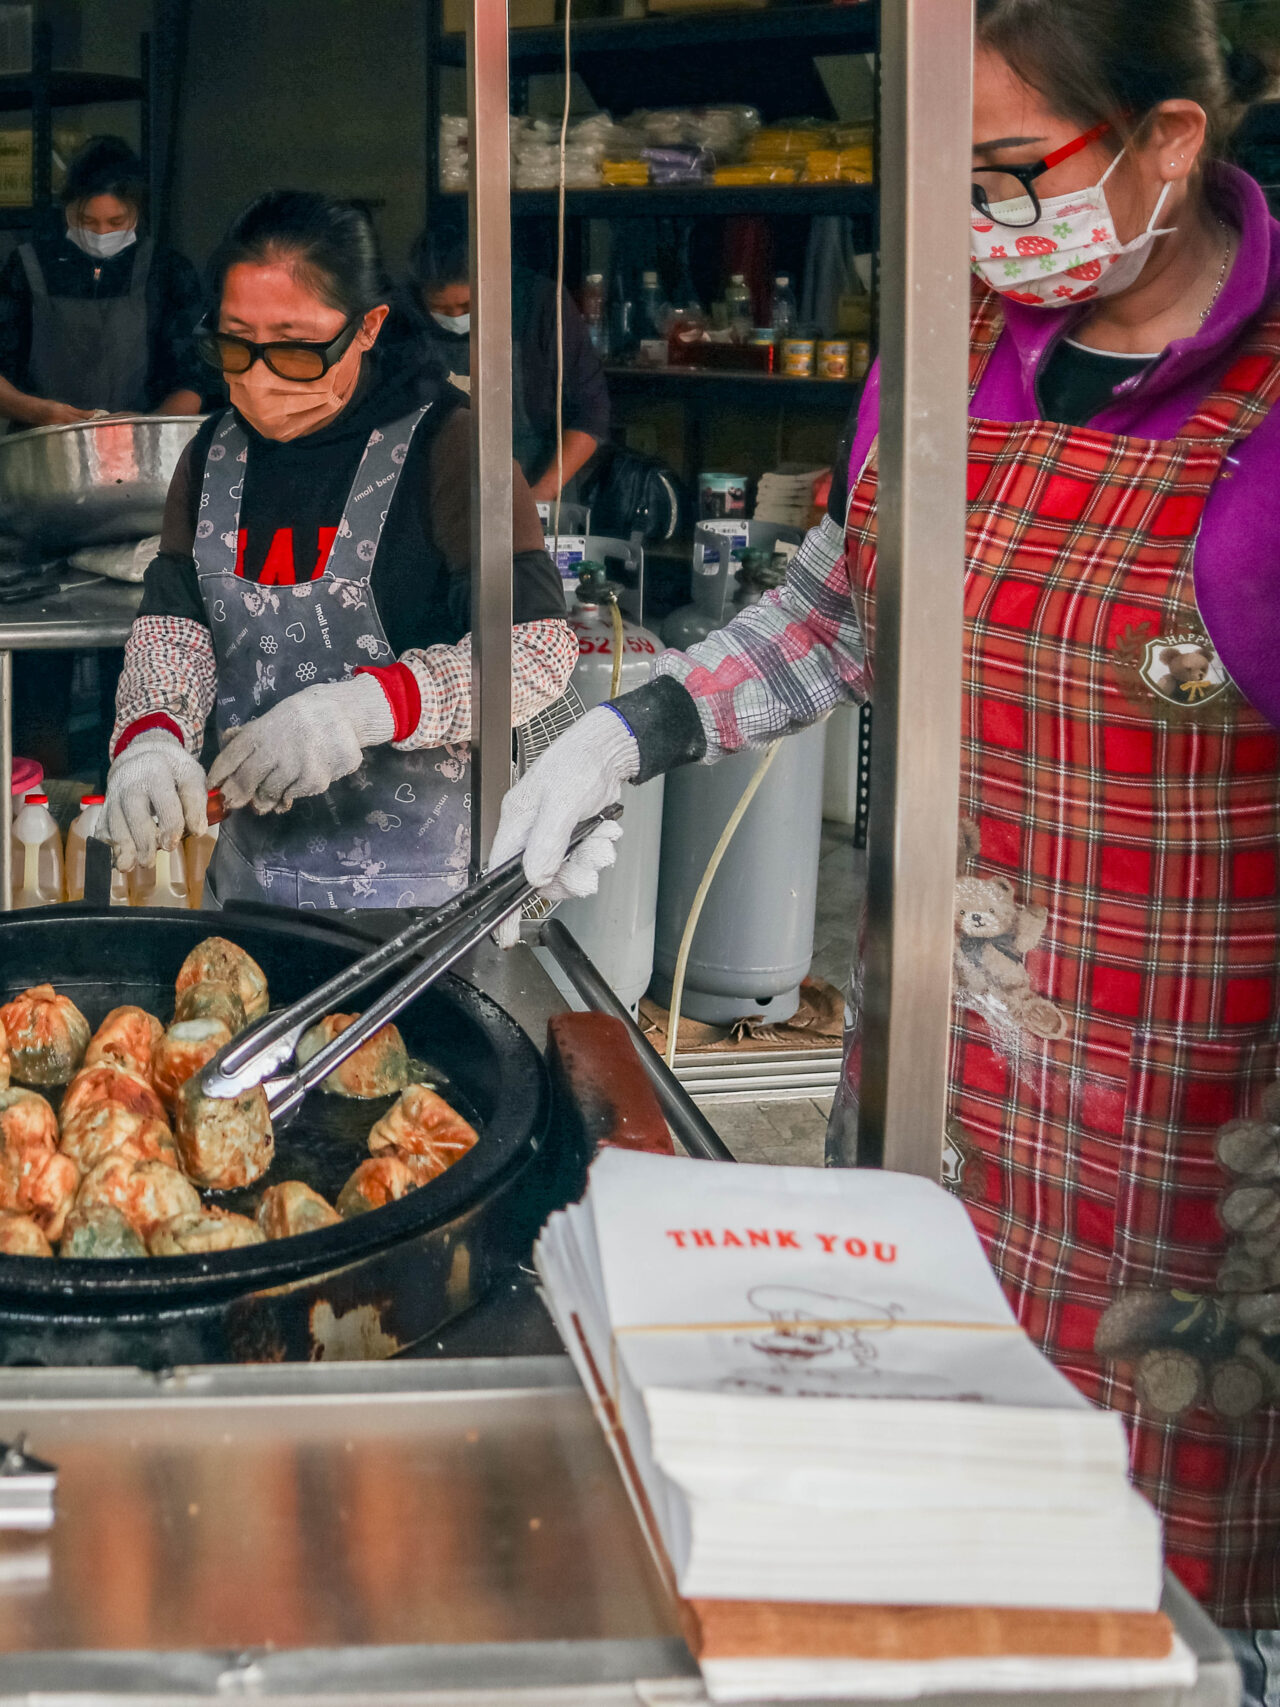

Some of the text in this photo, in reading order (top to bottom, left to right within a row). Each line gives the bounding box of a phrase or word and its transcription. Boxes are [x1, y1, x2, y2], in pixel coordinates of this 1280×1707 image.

[314, 603, 332, 649] small bear
[666, 1228, 897, 1263] THANK YOU
